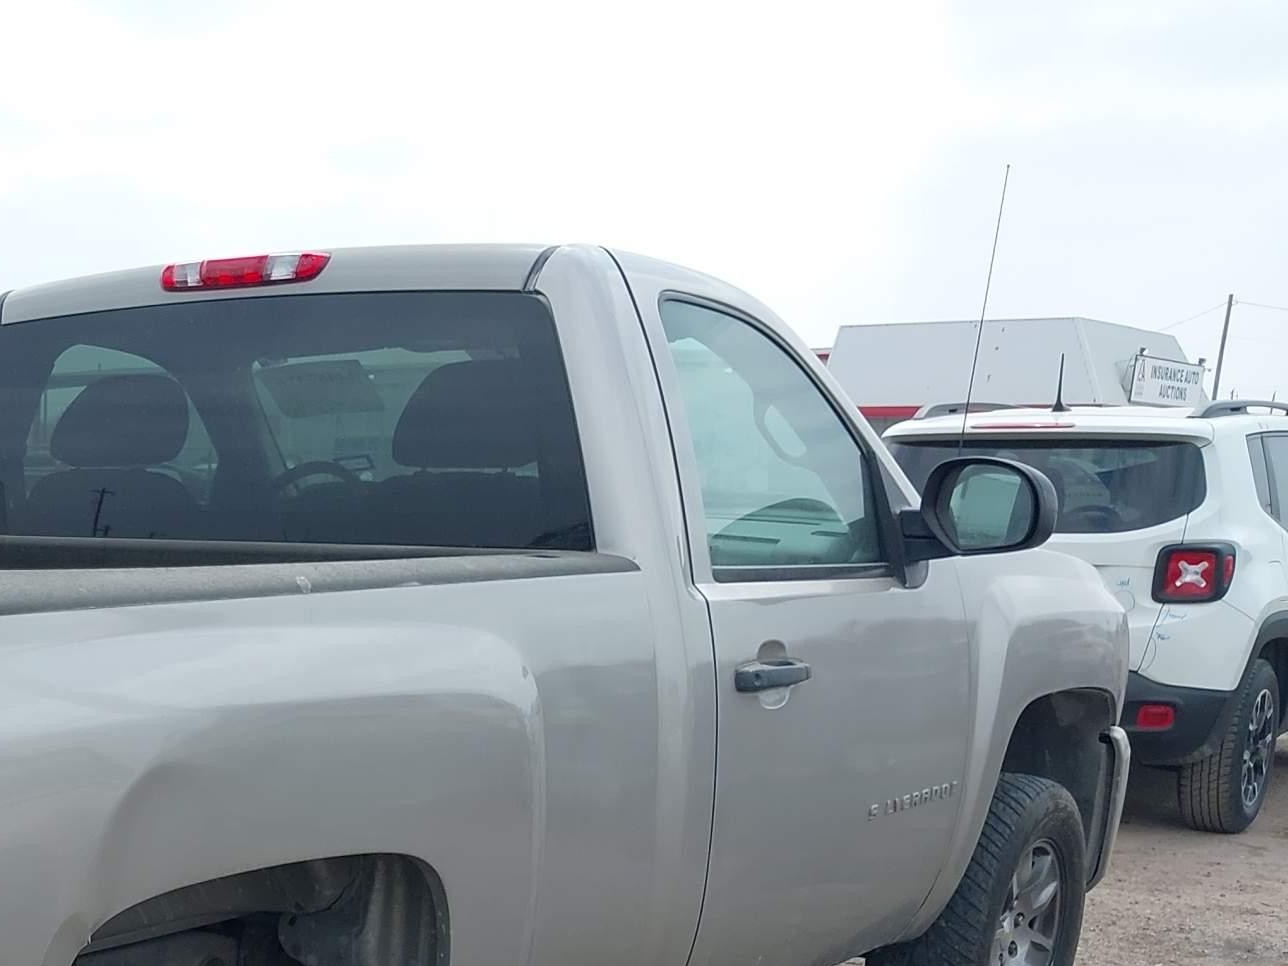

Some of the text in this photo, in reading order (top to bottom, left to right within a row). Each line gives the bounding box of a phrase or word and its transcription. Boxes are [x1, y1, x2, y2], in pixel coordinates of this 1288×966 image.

[1150, 366, 1184, 383] INSURANCE
[1184, 372, 1200, 385] AUTO
[1159, 385, 1187, 401] AUCTIONS
[868, 780, 958, 822] SLVERADO
